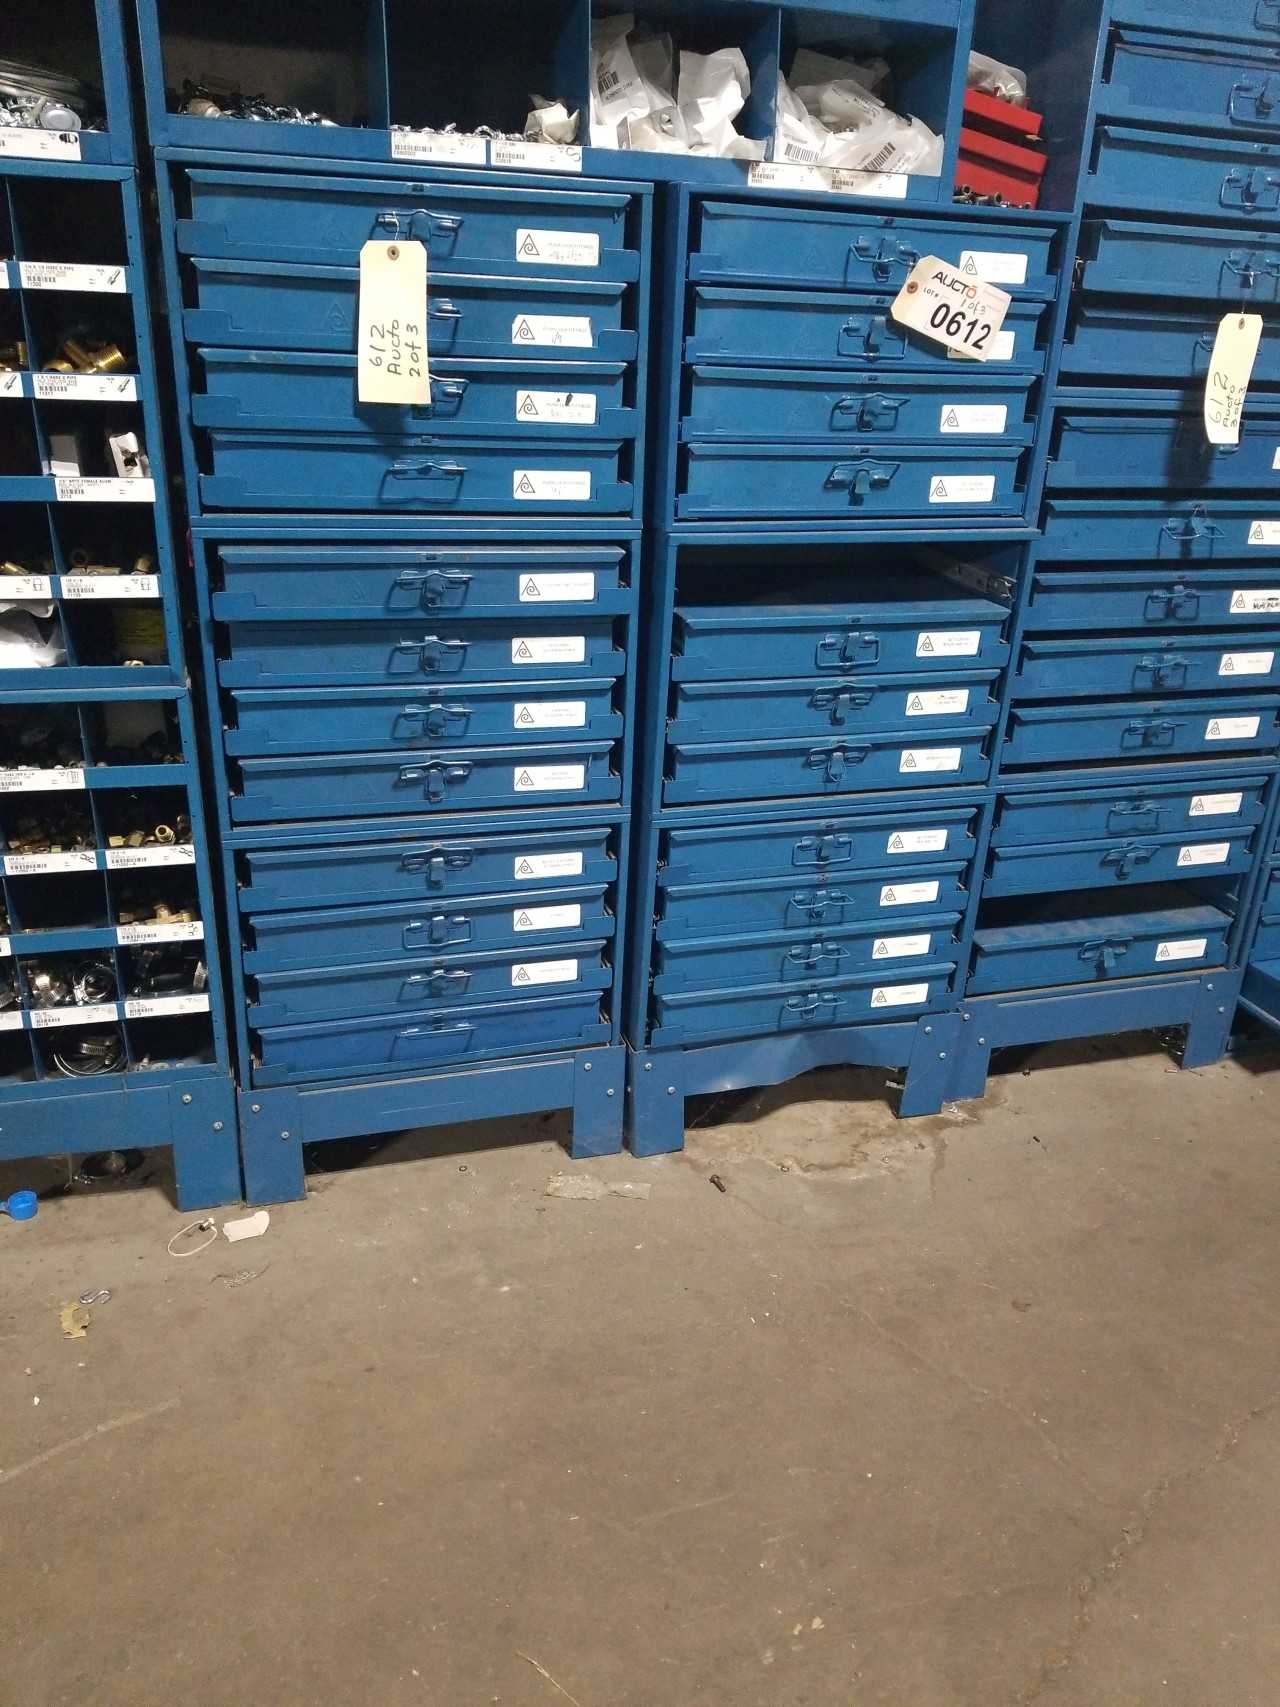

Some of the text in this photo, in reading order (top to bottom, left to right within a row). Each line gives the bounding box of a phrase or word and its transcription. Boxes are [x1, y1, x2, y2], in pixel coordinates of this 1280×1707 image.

[923, 286, 935, 297] LOT
[931, 271, 978, 300] AUCTO
[369, 323, 386, 367] 612
[930, 303, 992, 350] 0612
[404, 323, 422, 377] 2 of 3
[1208, 371, 1229, 424] 612
